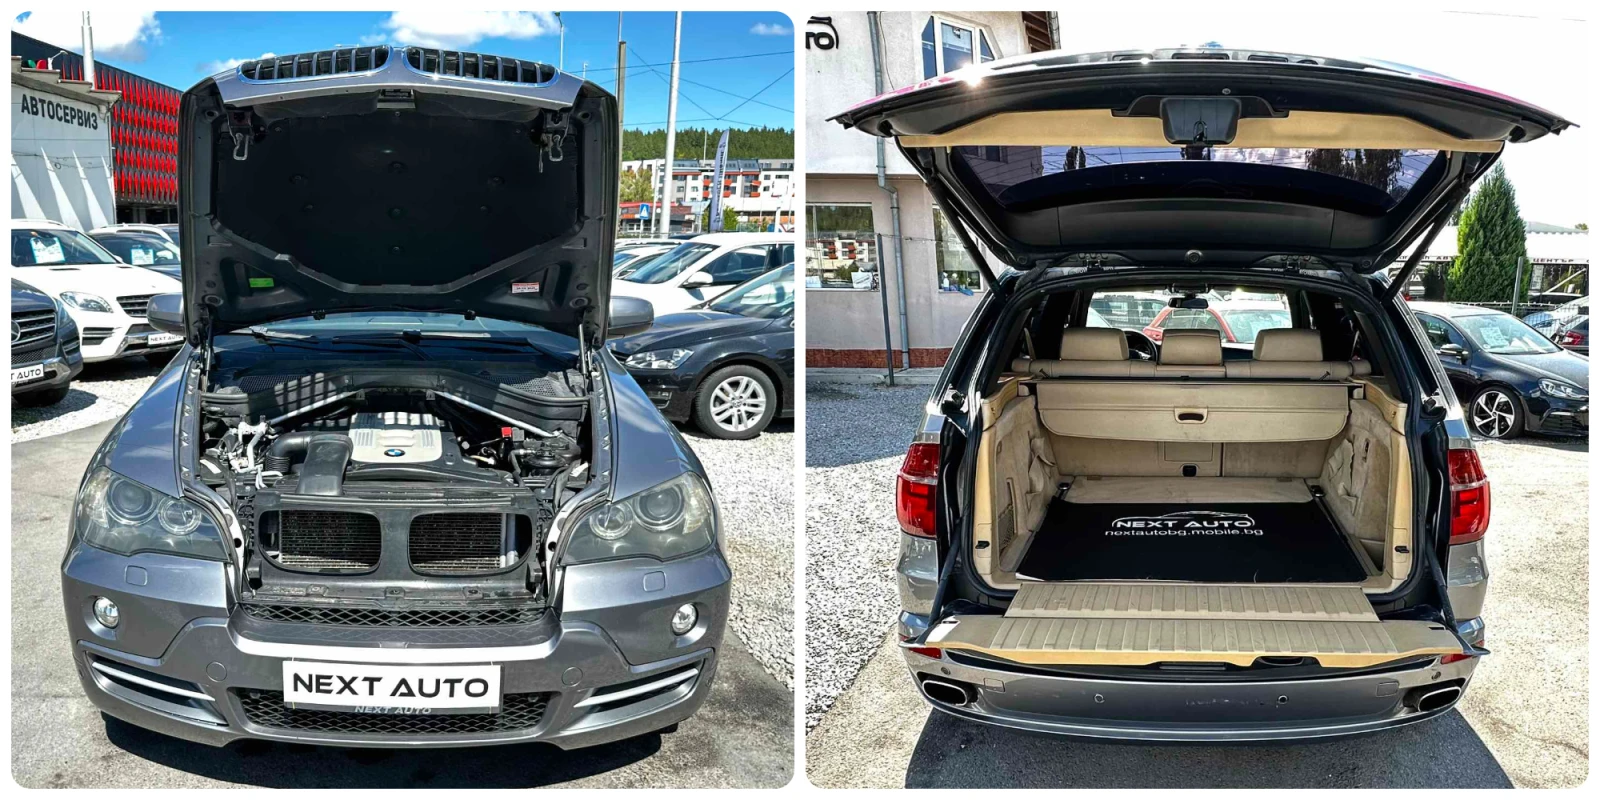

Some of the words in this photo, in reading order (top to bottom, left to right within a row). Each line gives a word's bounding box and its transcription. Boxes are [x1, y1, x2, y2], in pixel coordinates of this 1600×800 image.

[21, 94, 98, 130] АВТОСЕРВИЗ
[17, 368, 41, 380] AUTO
[1116, 520, 1178, 528] NEXT
[1184, 520, 1252, 528] AUTO
[293, 672, 383, 696] NEXT
[389, 677, 489, 698] AUTO
[354, 705, 392, 714] NEXT
[394, 706, 432, 715] AUTO
